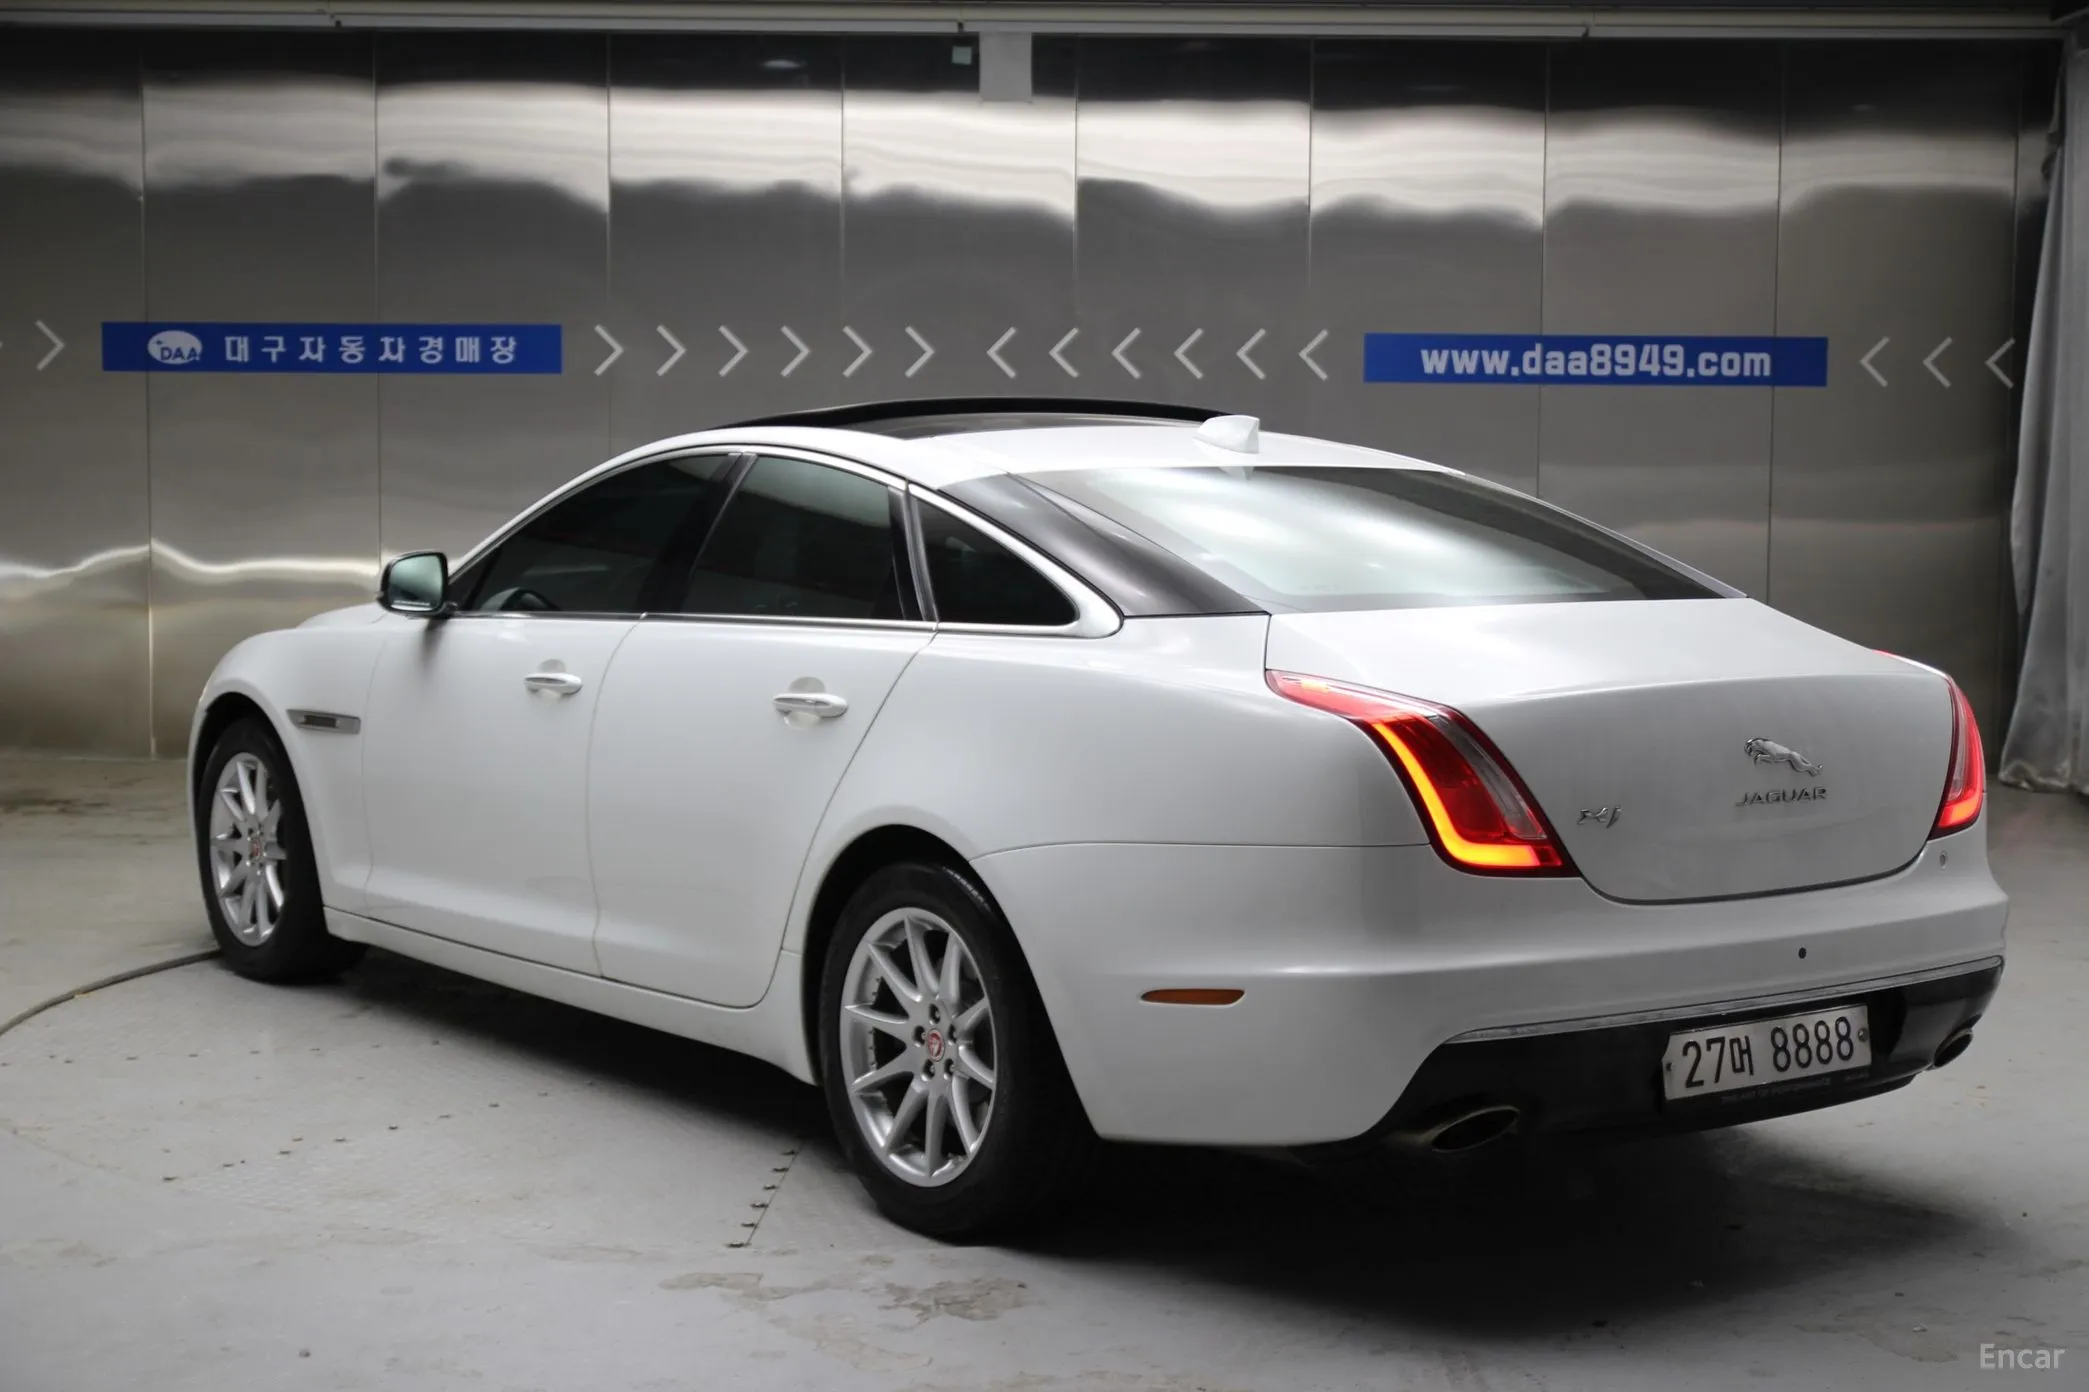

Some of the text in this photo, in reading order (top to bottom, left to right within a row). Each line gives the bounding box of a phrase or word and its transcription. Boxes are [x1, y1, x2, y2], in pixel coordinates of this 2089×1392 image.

[160, 346, 201, 361] DAA
[1420, 343, 1772, 378] www.daa8949.com
[1735, 786, 1828, 807] JAGUAR
[1682, 1016, 1854, 1089] 27머 8888
